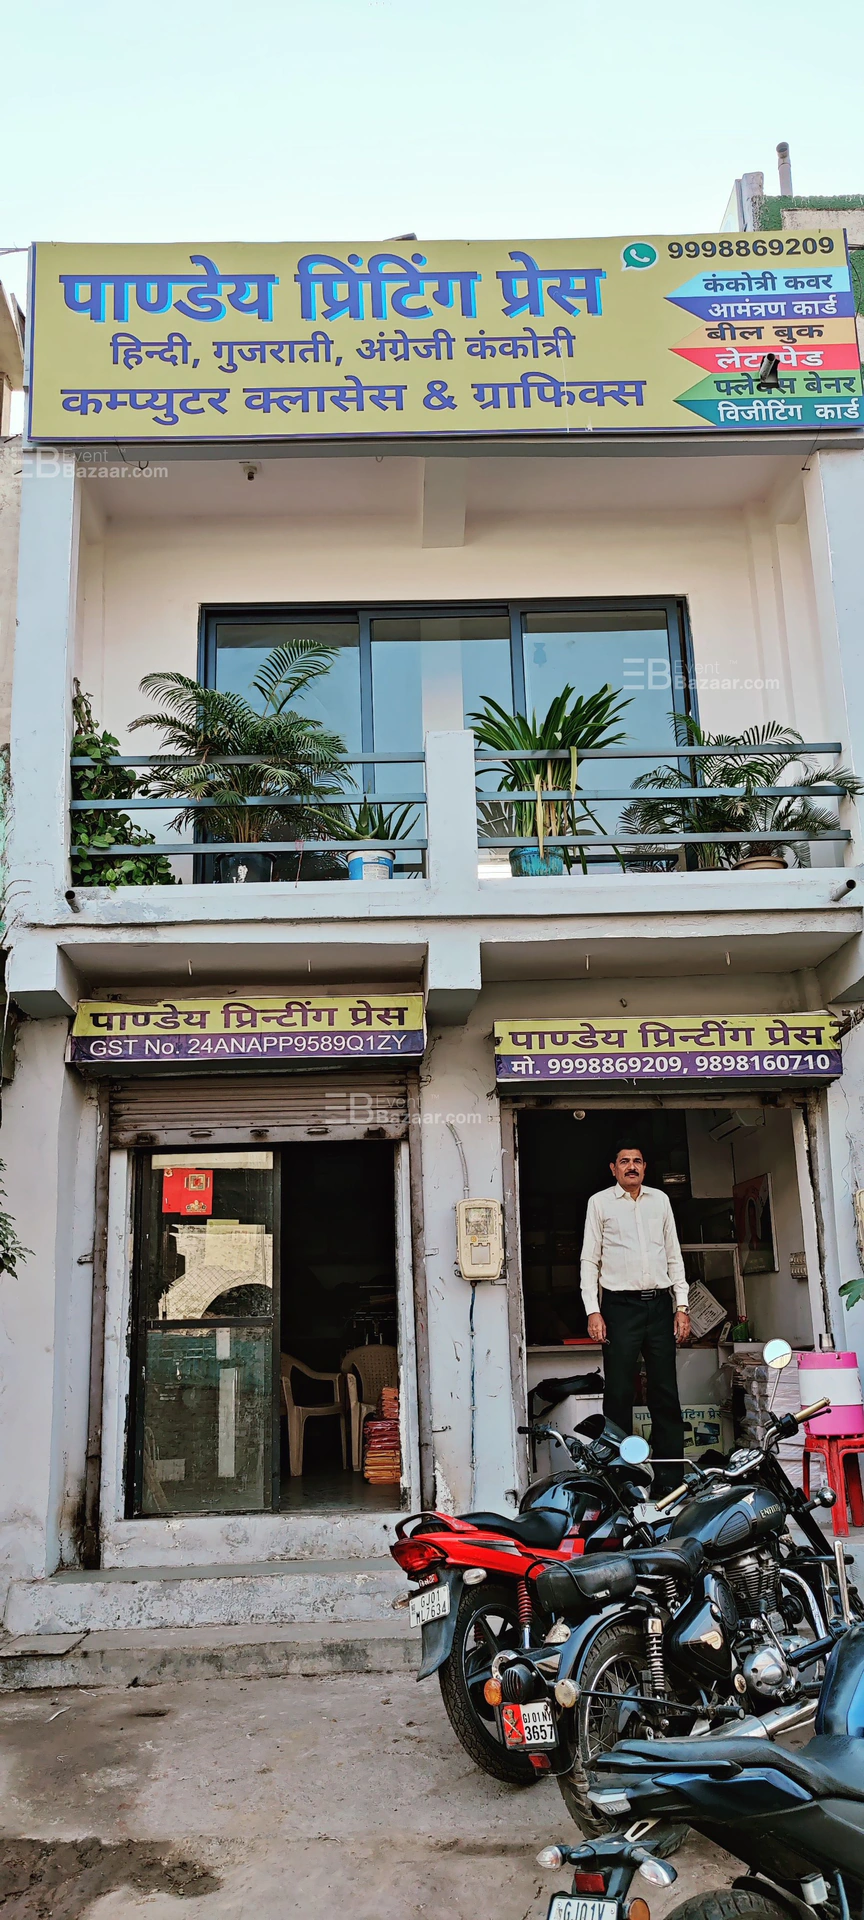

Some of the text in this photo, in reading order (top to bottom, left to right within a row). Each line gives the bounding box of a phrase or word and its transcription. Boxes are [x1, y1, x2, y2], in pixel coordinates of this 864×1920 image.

[667, 236, 835, 259] 9998869209
[59, 251, 607, 322] पाण्डेय प्रिंटिंग प्रेस
[702, 270, 833, 293] कंकोत्री कवर
[708, 294, 838, 318] आमंत्रण कार्ड
[705, 321, 824, 344] बील बुक
[110, 326, 576, 374] हिन्दी, गुजराती, अंग्रेजी कंकोत्री
[715, 345, 825, 369] लेटपेड
[803, 371, 857, 394] बेनर
[60, 371, 647, 426] कम्प्युटर क्लासेस & ग्राफिक्स
[717, 397, 861, 422] विजीटिंग कार्ड
[89, 1000, 408, 1031] पाण्डेय प्रिन्टींग प्रेस
[89, 1034, 407, 1057] GST No. 24ANAPP9589Q1ZY
[508, 1019, 825, 1050] पाण्डेय प्रिन्टींग प्रेस
[511, 1054, 831, 1075] मो. 9998869209, 9898160710
[420, 1589, 440, 1608] GJ01
[416, 1600, 447, 1625] ML7634
[524, 1724, 553, 1741] 3657
